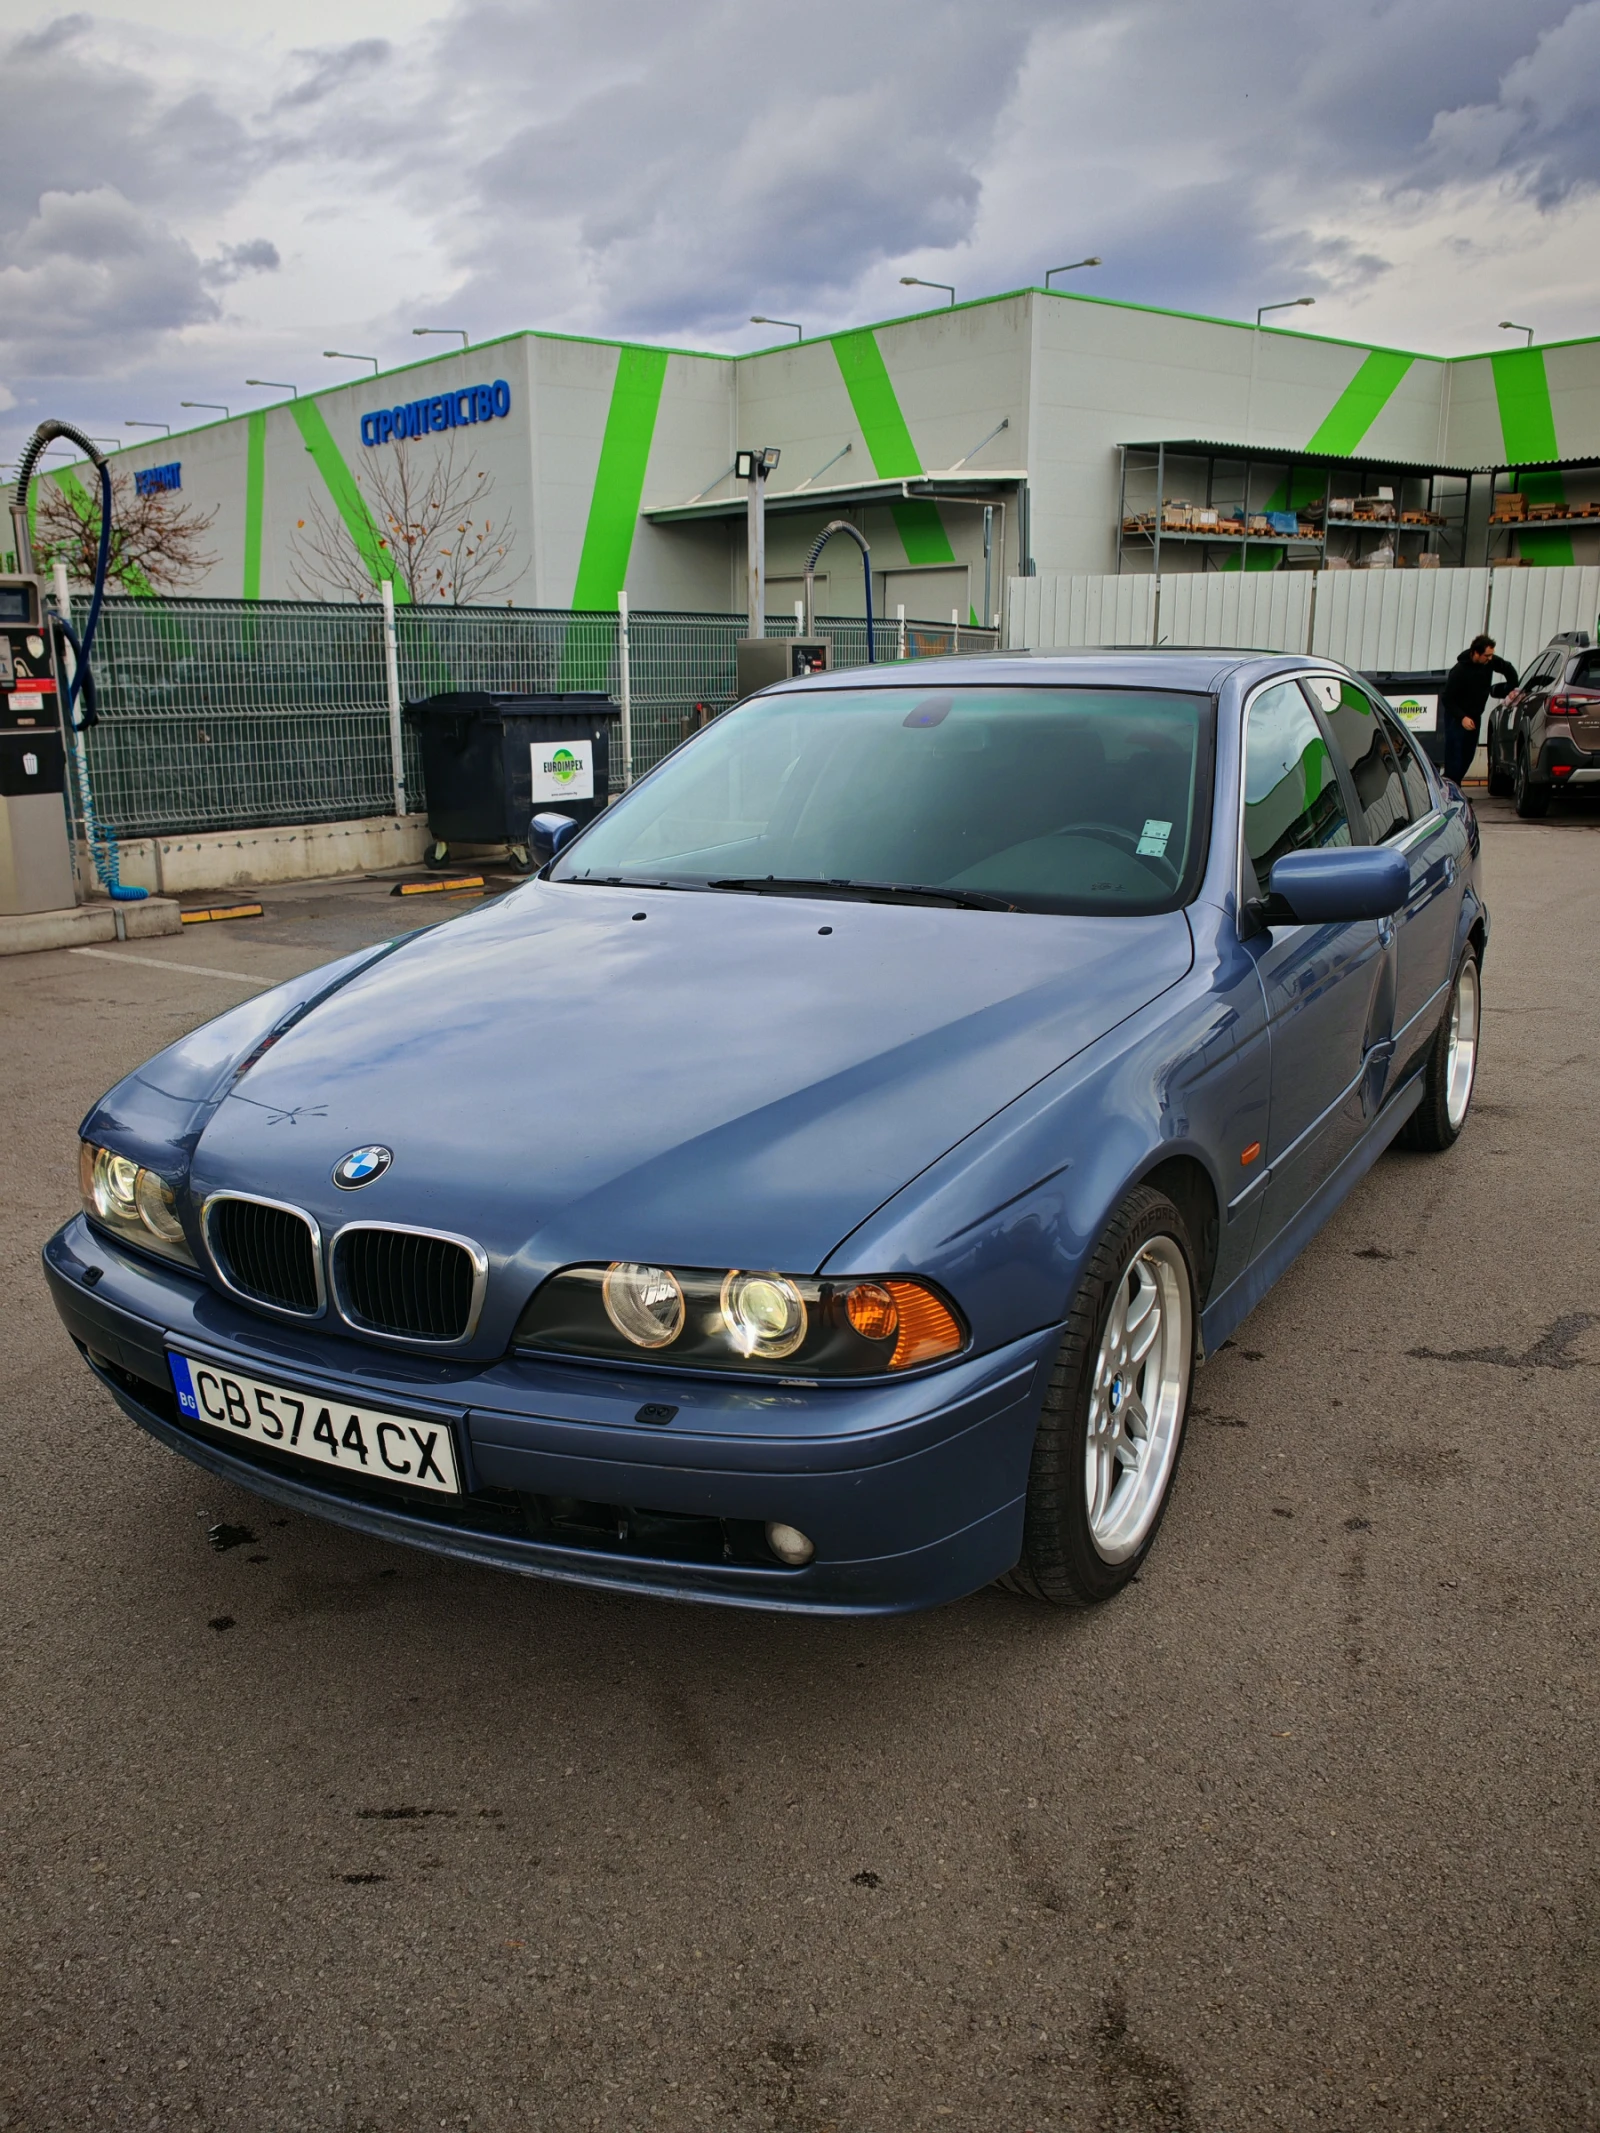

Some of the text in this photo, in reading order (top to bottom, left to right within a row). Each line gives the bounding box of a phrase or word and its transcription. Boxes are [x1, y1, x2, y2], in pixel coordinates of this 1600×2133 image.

[360, 379, 511, 448] СТРОИТЕЛСТВО
[543, 760, 583, 773] EUROIMPEX
[179, 1391, 197, 1410] BG
